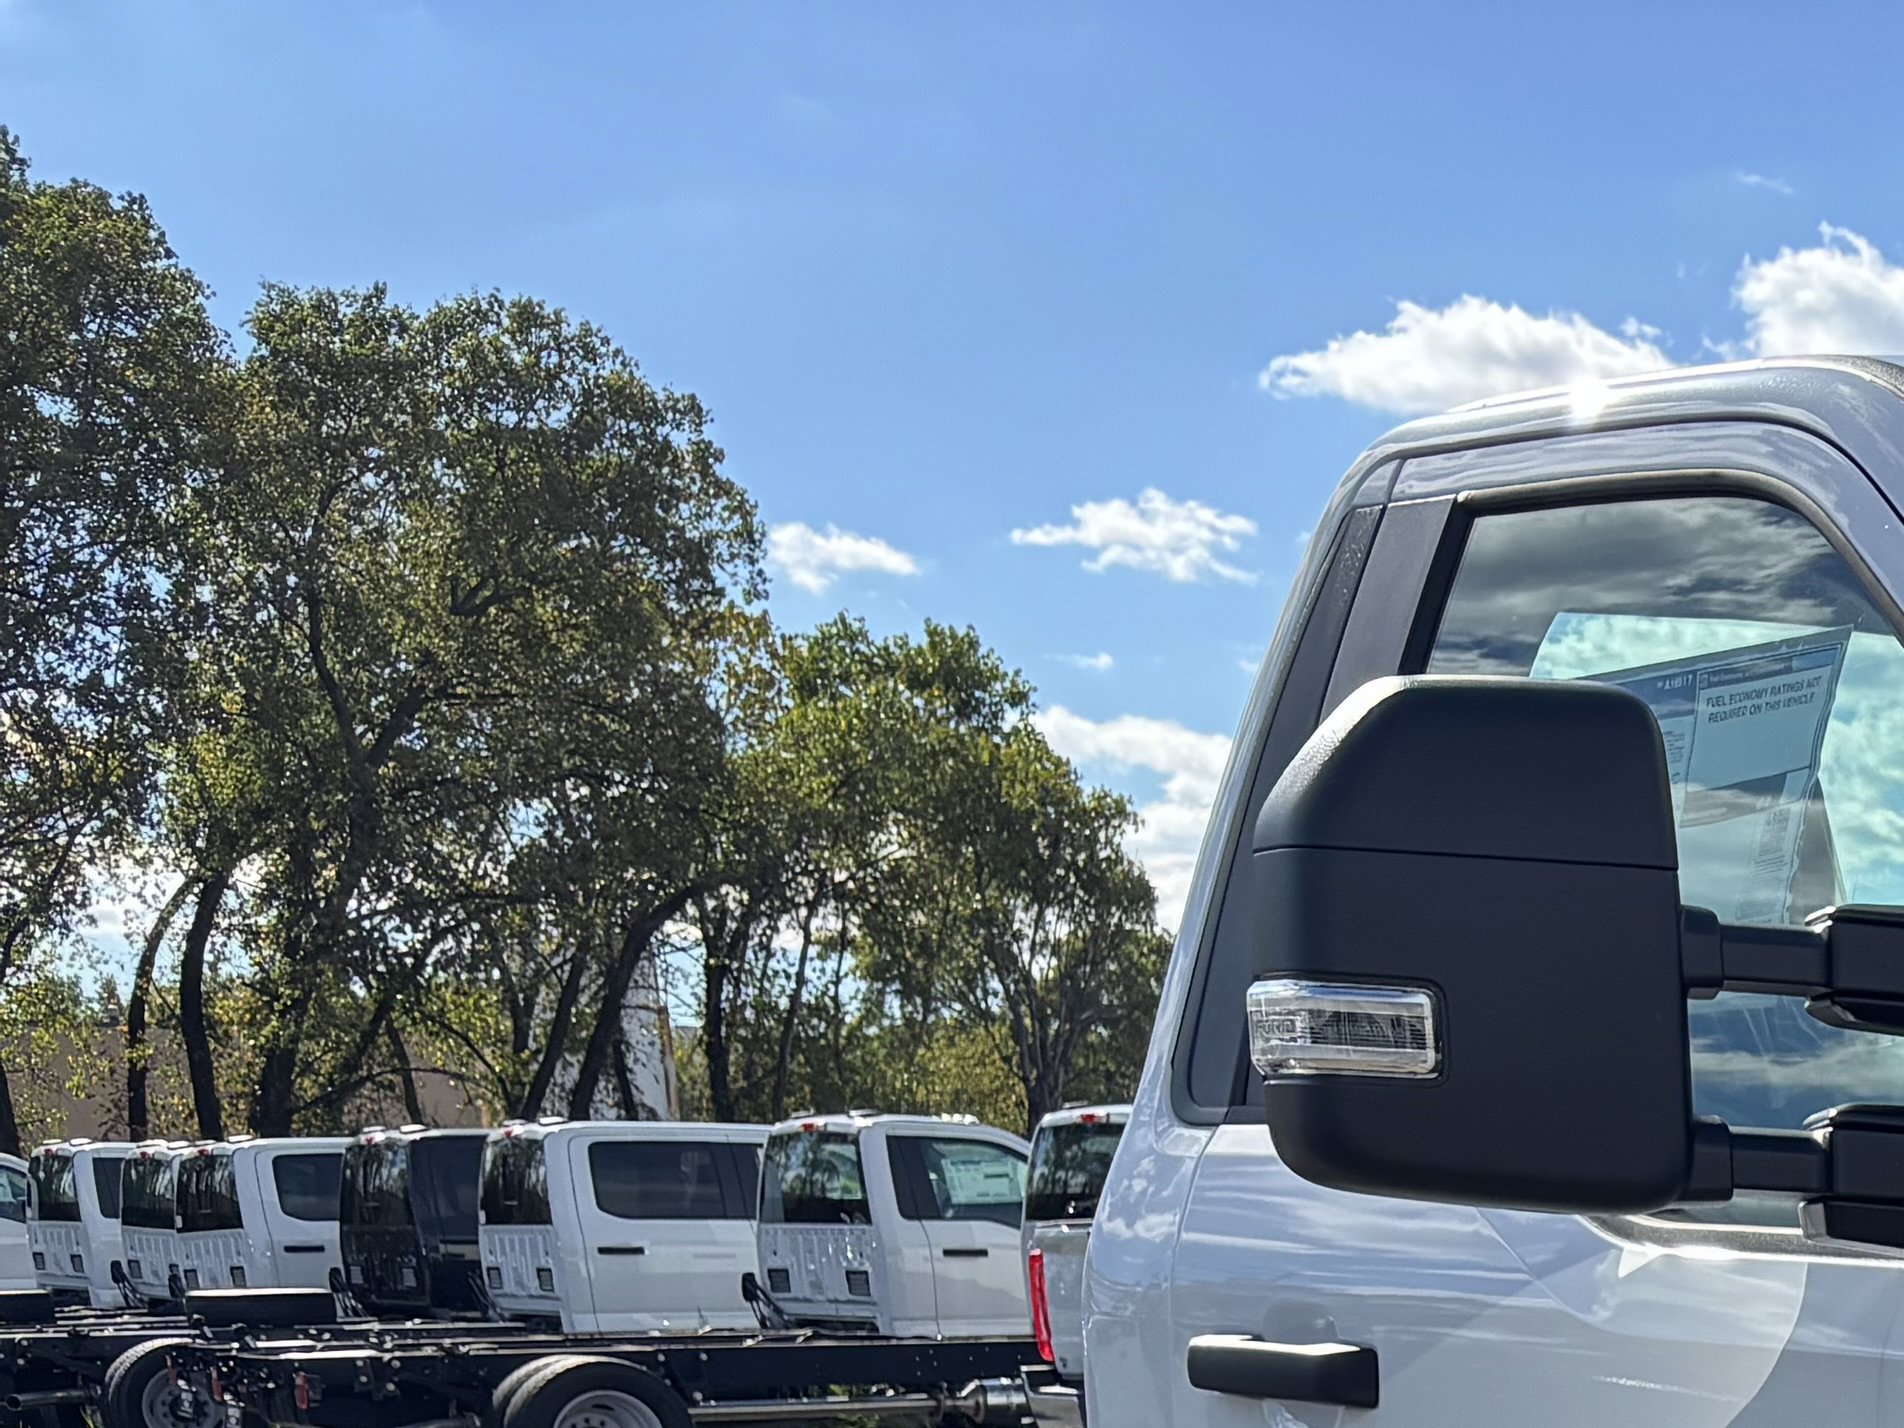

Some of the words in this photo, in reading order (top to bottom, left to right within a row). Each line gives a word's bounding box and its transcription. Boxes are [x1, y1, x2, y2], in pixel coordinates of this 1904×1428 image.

[1706, 695, 1726, 708] FUEL
[1729, 689, 1769, 705] ECONOMY
[1769, 681, 1804, 697] RATINGS
[1708, 706, 1747, 723] REQUIRED
[1748, 704, 1762, 715] ON
